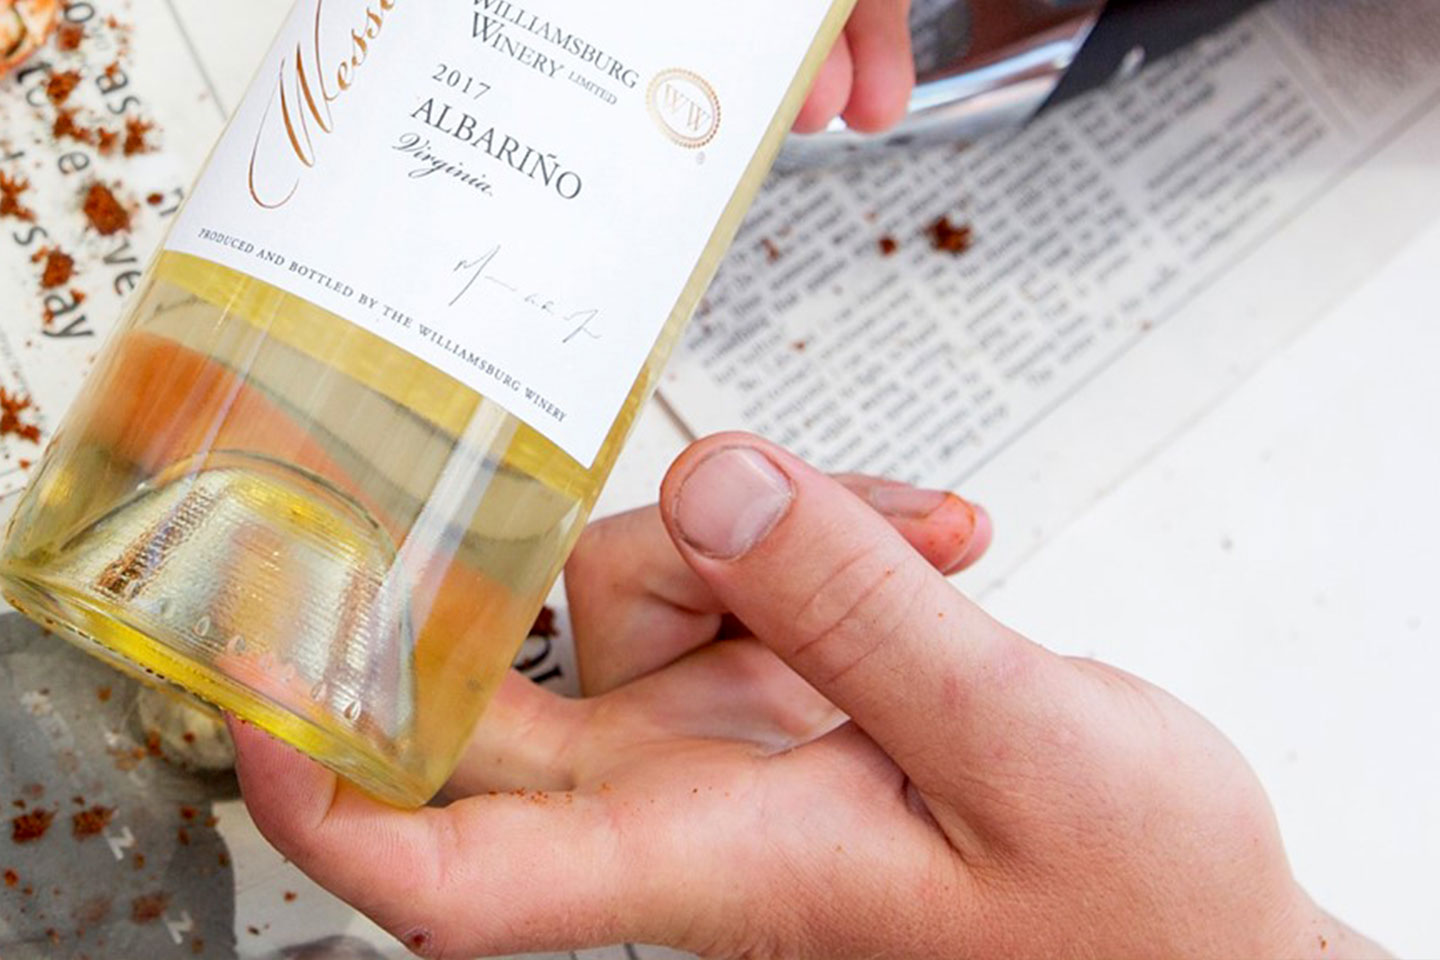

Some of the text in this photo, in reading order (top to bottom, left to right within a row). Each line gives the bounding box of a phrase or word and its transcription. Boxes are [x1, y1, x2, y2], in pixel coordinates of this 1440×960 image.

[431, 62, 492, 101] 2017
[470, 10, 618, 106] WINERY LIMITED
[410, 95, 583, 200] ALBARIÑO
[197, 227, 569, 424] PRODUCED AND BOTTLED BY THE WILLIAMSBURG WINERY
